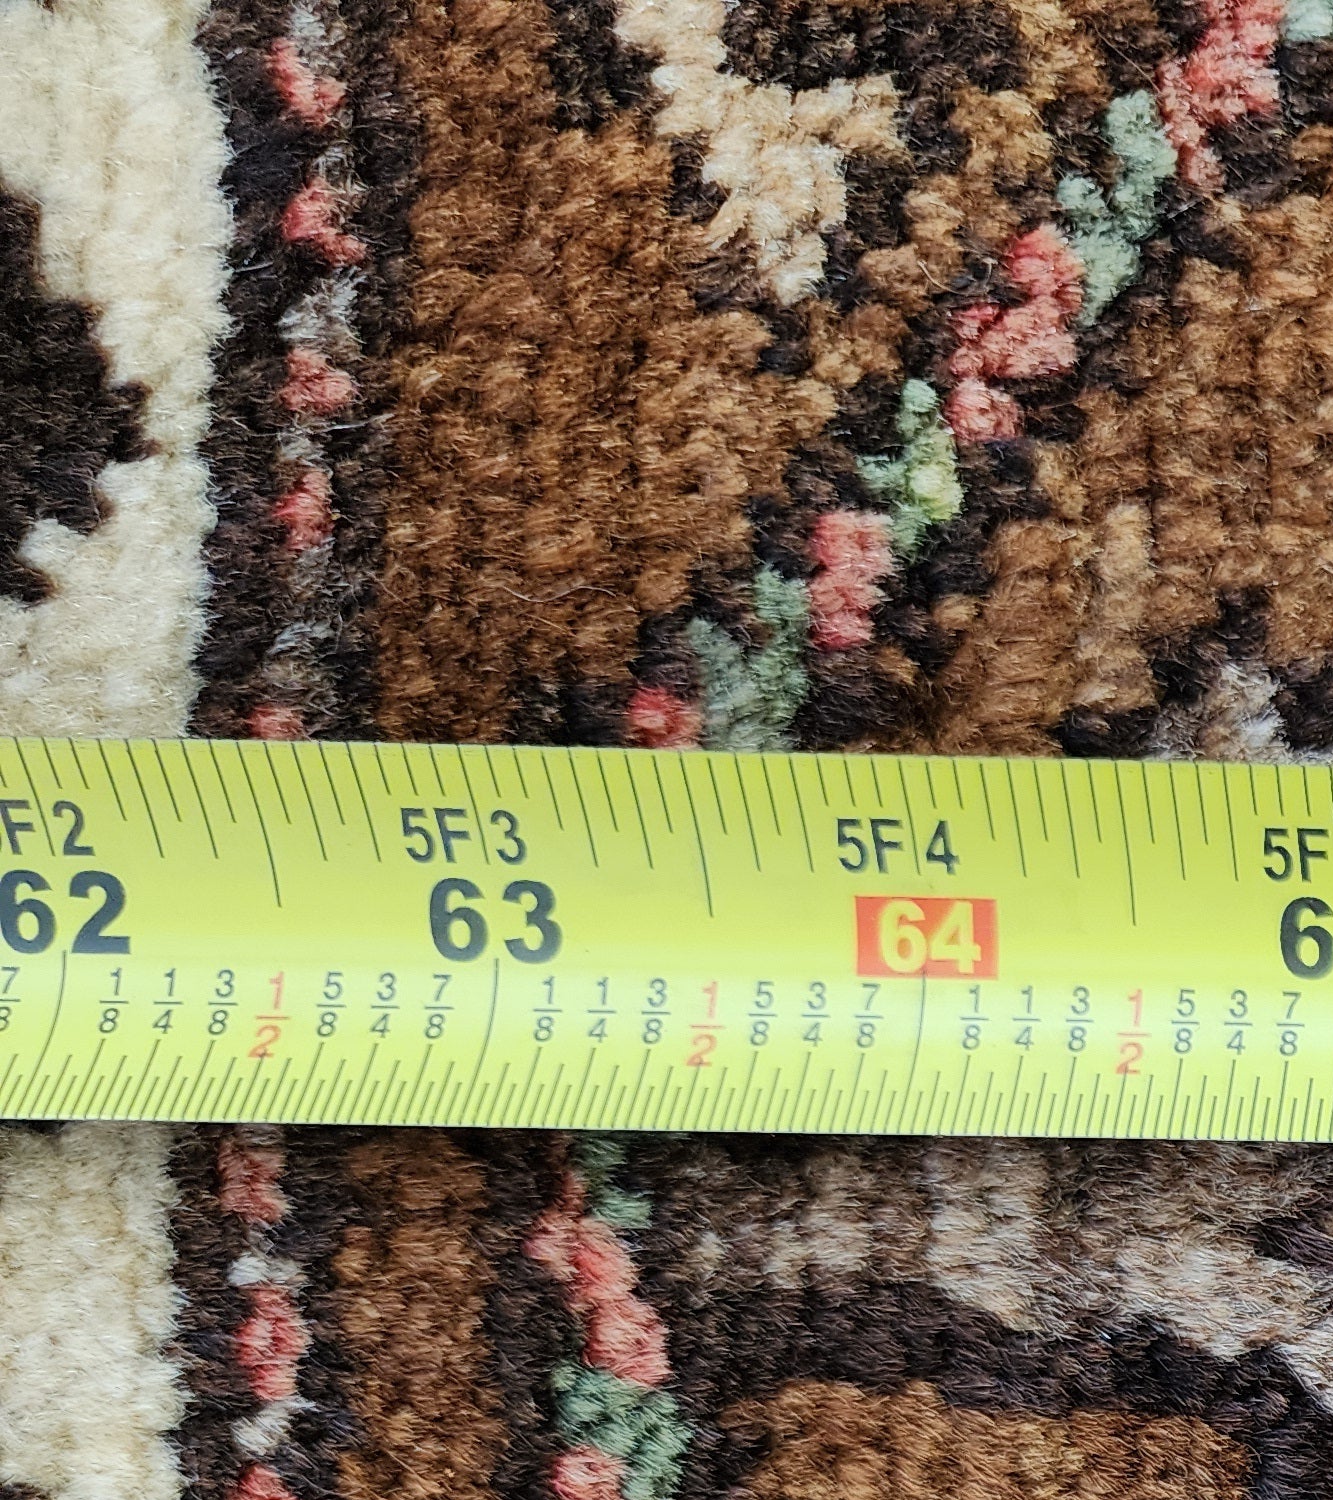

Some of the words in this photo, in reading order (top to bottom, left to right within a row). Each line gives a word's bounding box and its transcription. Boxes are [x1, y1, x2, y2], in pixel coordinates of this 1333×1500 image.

[0, 869, 131, 955] 62
[429, 878, 563, 964] 63
[879, 899, 982, 974] 64
